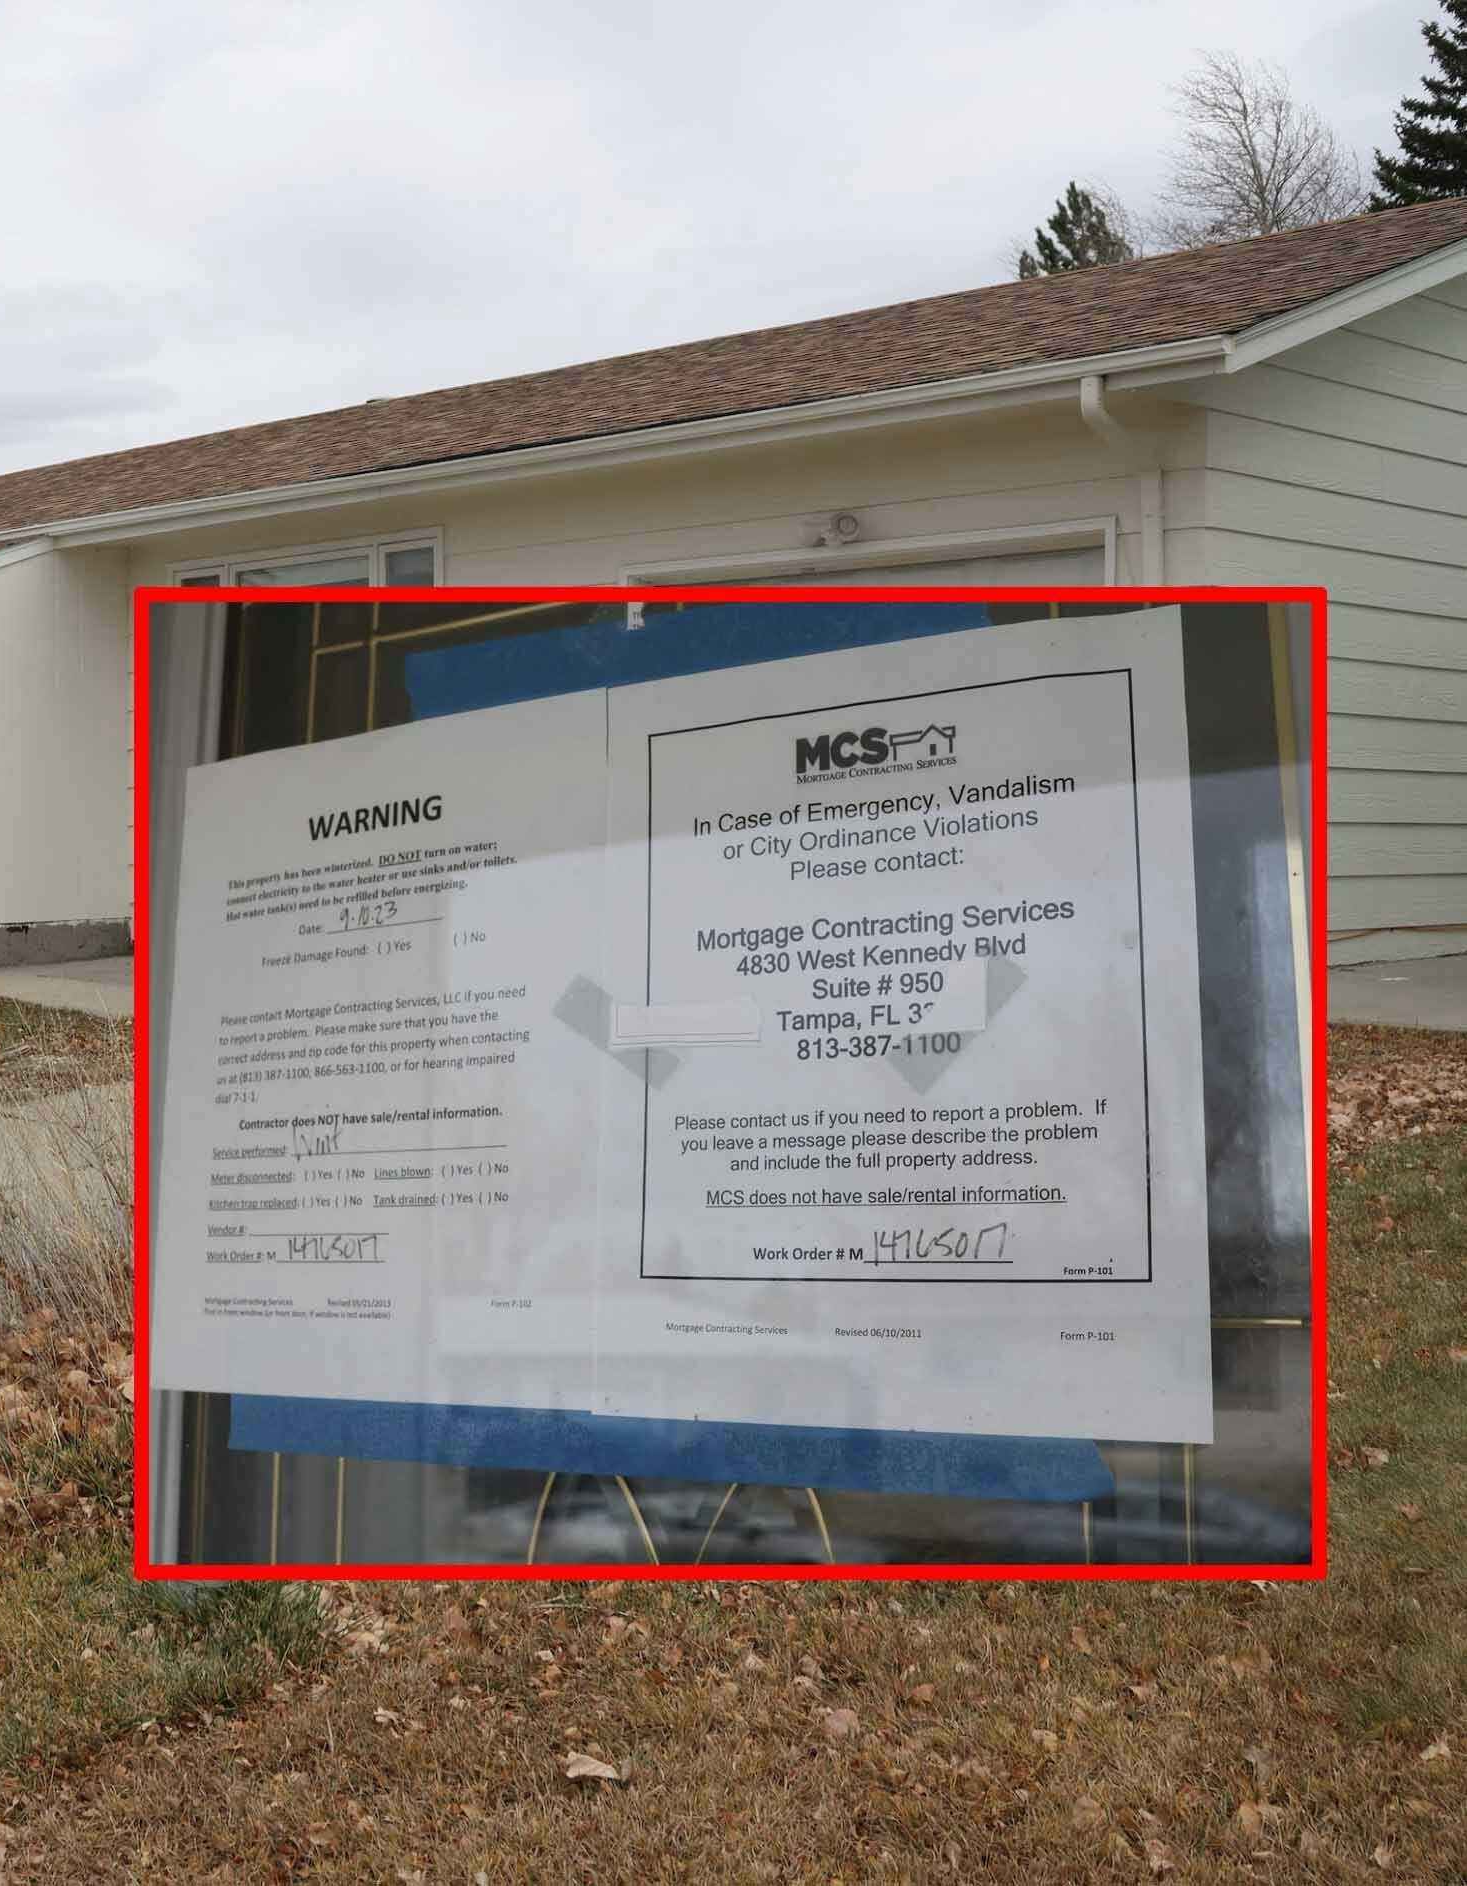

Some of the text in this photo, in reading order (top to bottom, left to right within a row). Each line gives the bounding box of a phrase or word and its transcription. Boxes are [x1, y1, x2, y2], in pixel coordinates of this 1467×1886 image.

[795, 727, 890, 775] MCS
[308, 794, 442, 841] WARNING
[694, 775, 1075, 837] In Case of Emergency, Vandalism
[723, 809, 1038, 860] or City Ordinance Violations
[377, 853, 396, 869] DO
[396, 849, 422, 866] NOT
[424, 848, 446, 859] turn
[448, 846, 462, 856] on
[418, 863, 446, 877] sinks
[446, 859, 481, 873] and/or
[483, 855, 518, 869] toilets.
[790, 847, 964, 881] Please contact:
[697, 900, 1075, 952] Mortgage Contracting Services
[293, 951, 334, 965] Damage
[736, 932, 1026, 976] 4830 West Kennedy Blvd
[812, 970, 944, 1000] Suite # 950
[284, 1006, 332, 1020] Mortgage
[333, 999, 394, 1015] Contracting
[395, 993, 441, 1011] Services,
[442, 991, 462, 1007] LLC
[473, 991, 495, 1004] you
[497, 984, 526, 1000] need
[314, 1024, 347, 1039] Please
[347, 1020, 378, 1033] make
[378, 1019, 404, 1033] sure
[403, 1016, 427, 1030] that
[428, 1015, 449, 1030] you
[451, 1013, 478, 1025] have
[479, 1009, 499, 1023] the
[775, 1010, 862, 1034] Tampa,
[870, 1003, 902, 1027] FL
[323, 1044, 349, 1057] code
[350, 1043, 367, 1055] for
[368, 1040, 389, 1054] this
[390, 1037, 437, 1055] property
[438, 1034, 471, 1048] when
[471, 1029, 530, 1045] contacting
[796, 1032, 961, 1061] 813-387-1100
[390, 1061, 403, 1073] or
[403, 1058, 420, 1072] for
[422, 1056, 464, 1070] hearing
[465, 1050, 516, 1068] impaired
[238, 1105, 503, 1131] Contractor does NOT have sale/rental information.
[674, 1098, 1107, 1131] Please contact us if you need to report a problem. If
[681, 1122, 1098, 1156] you leave a message please describe the problem
[373, 1167, 399, 1180] Lines
[730, 1149, 1038, 1172] and include the full property address.
[372, 1193, 397, 1207] Tank
[706, 1184, 1066, 1206] MCS does not have sale/rental information.
[752, 1247, 865, 1262] Work Order # M
[1063, 1266, 1114, 1276] Form P-101
[754, 1325, 788, 1337] Services
[834, 1327, 922, 1339] Revised 06/10/2011
[1060, 1331, 1115, 1342] Form P-101
